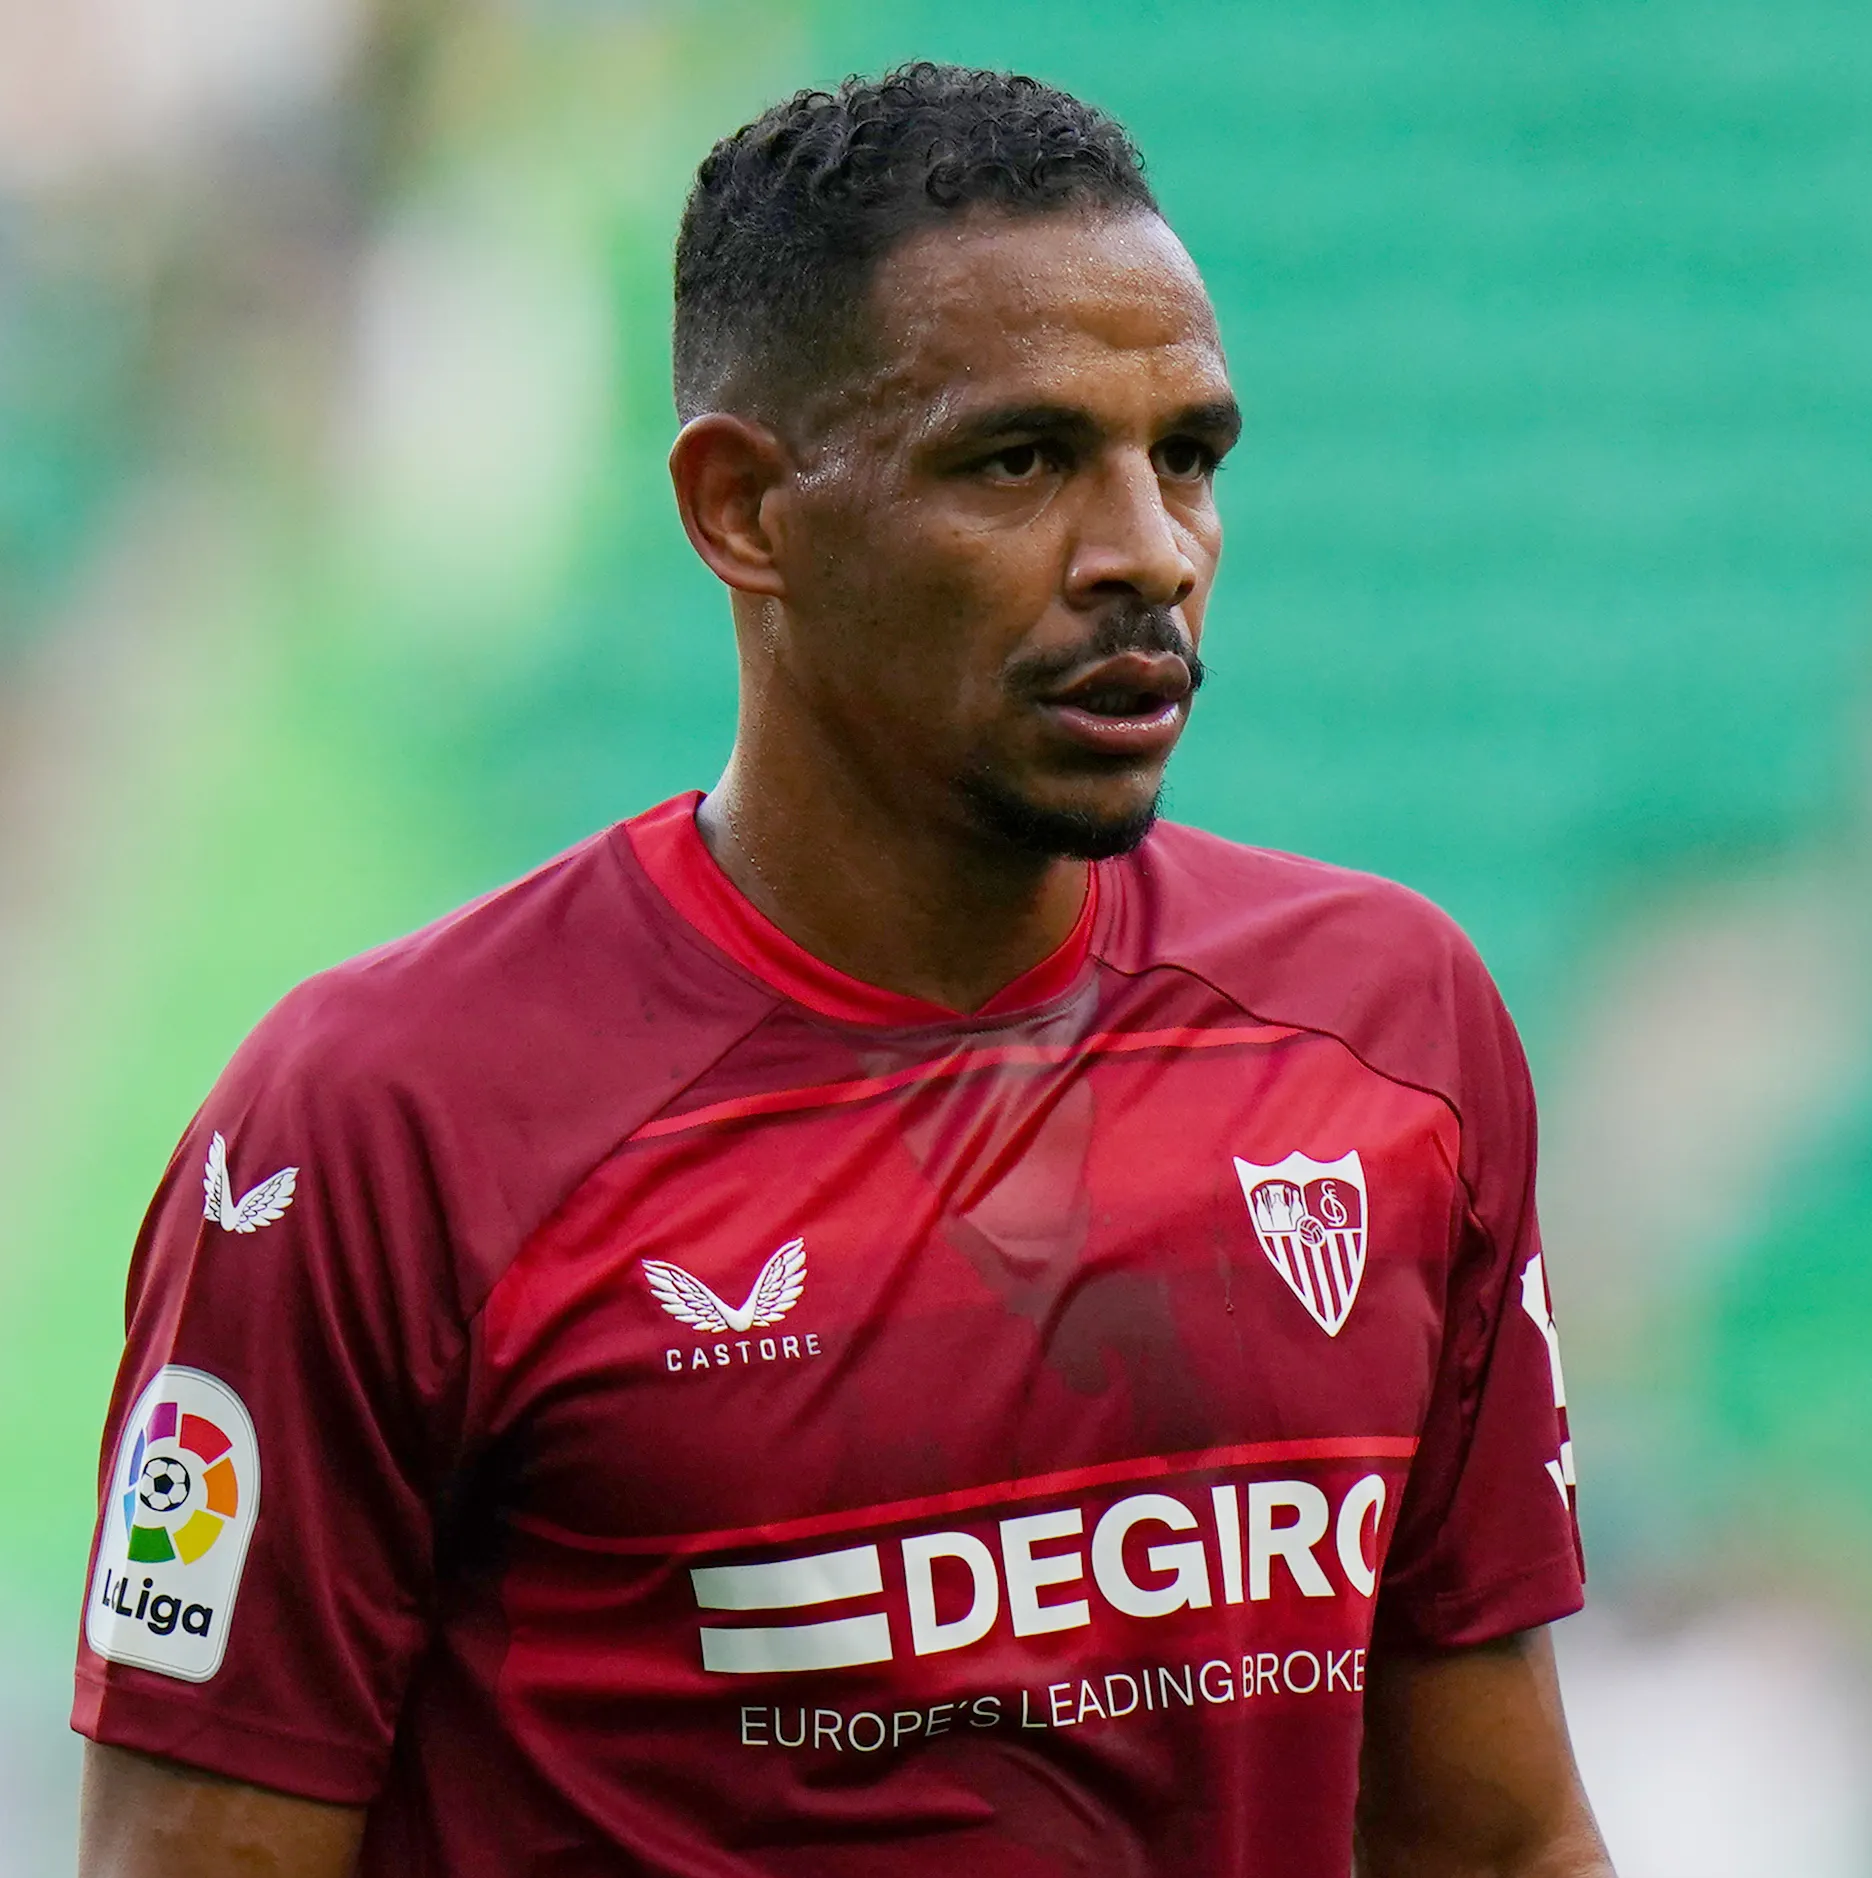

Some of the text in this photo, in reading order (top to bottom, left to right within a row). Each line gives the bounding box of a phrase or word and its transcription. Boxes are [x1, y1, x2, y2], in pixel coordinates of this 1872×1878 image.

[665, 1334, 822, 1372] CASTORE
[901, 1474, 1386, 1657] DEGIRO
[1022, 1658, 1234, 1728] LEADING
